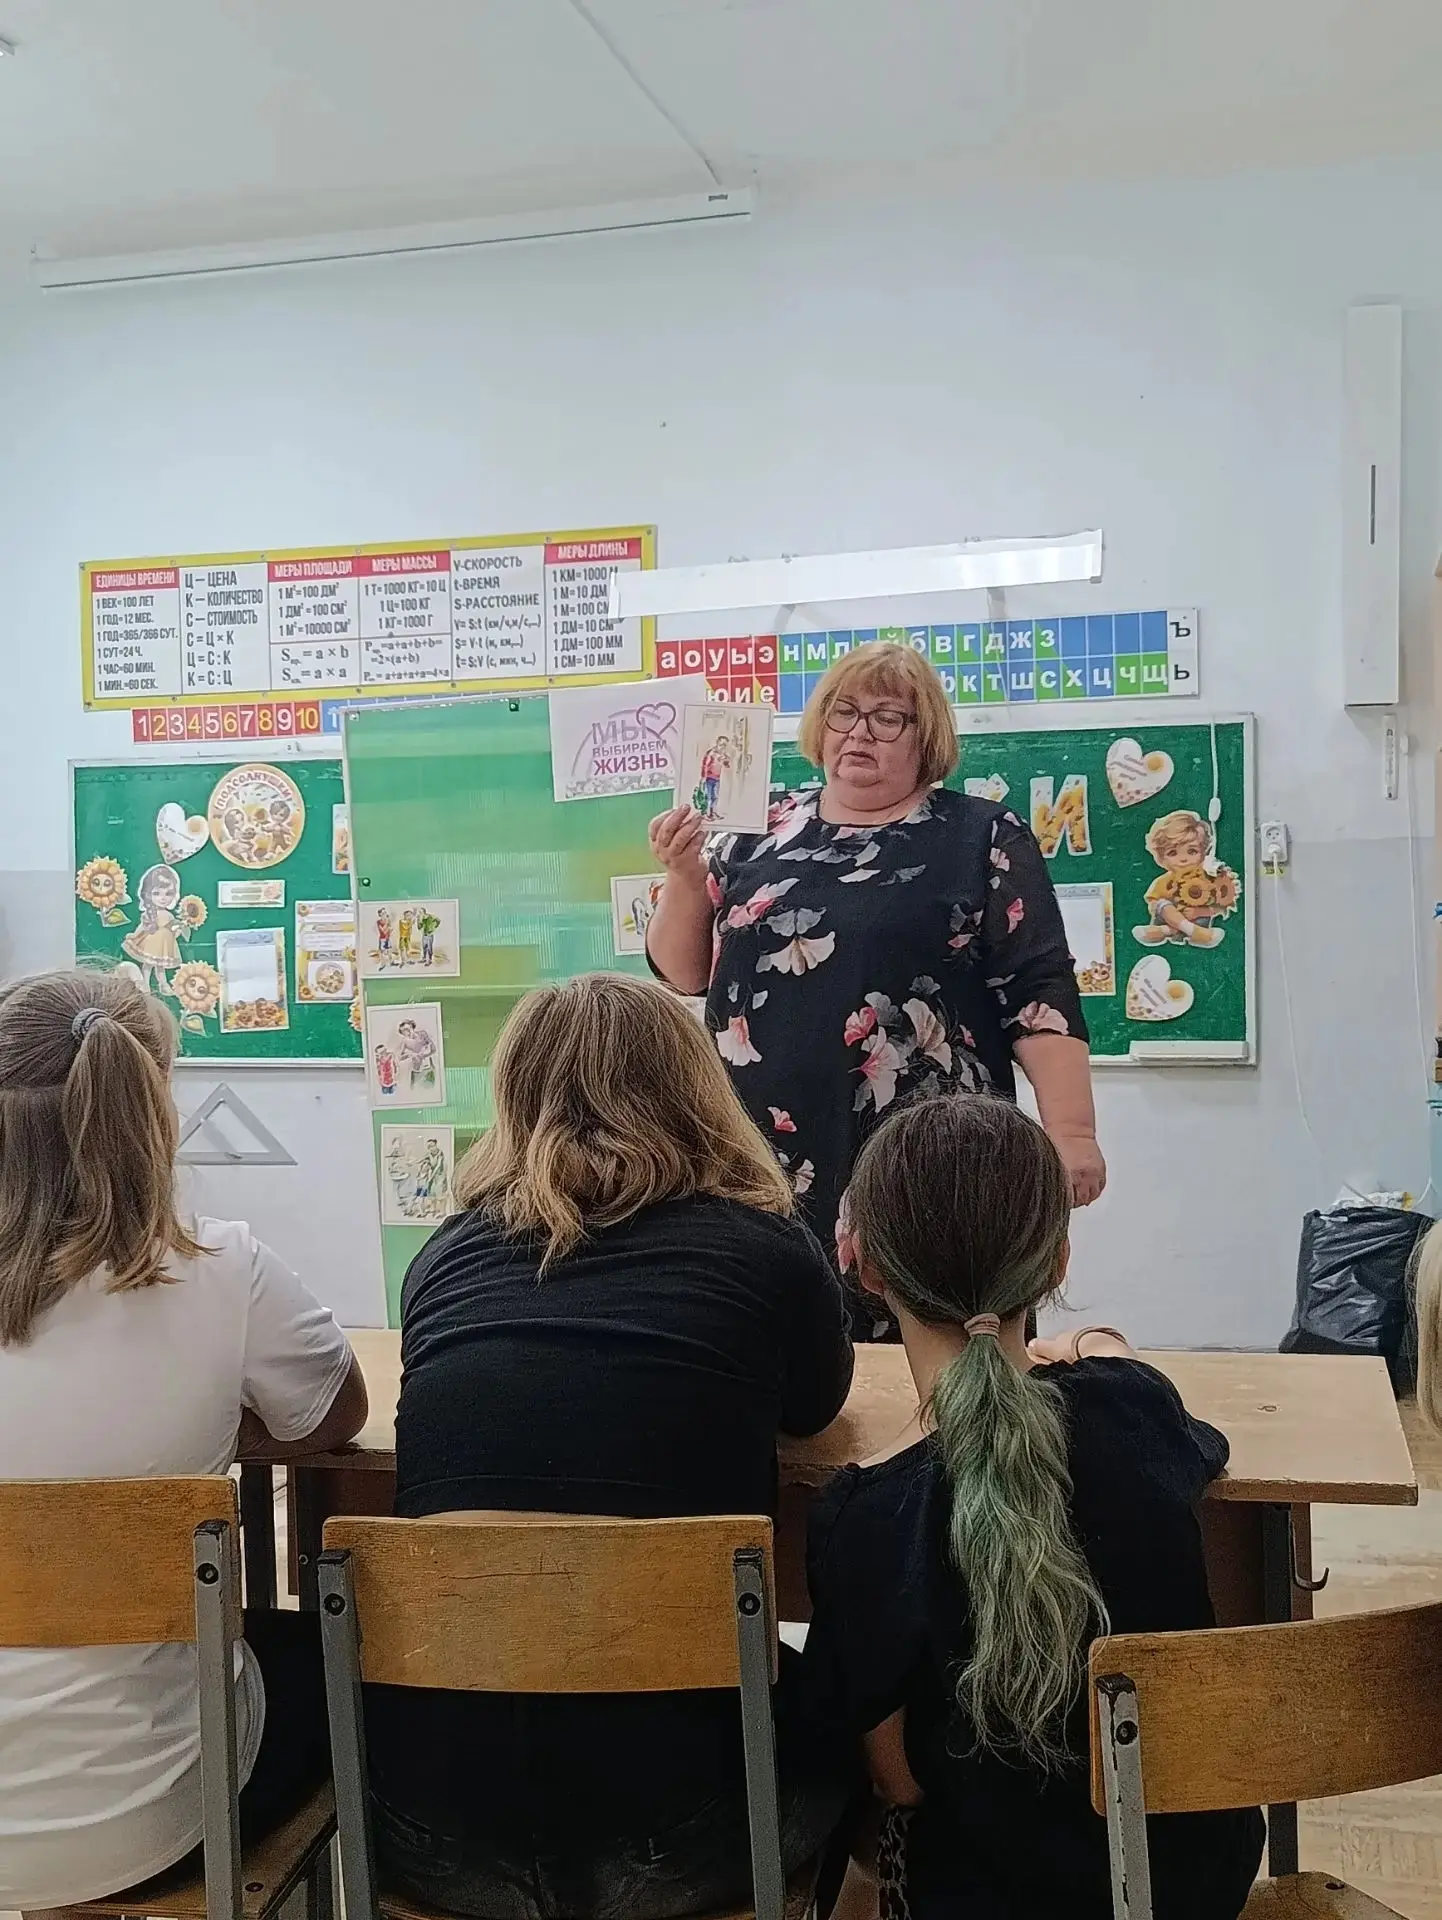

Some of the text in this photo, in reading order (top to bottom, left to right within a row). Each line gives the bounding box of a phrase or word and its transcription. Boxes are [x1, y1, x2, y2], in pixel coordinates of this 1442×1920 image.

[557, 541, 628, 559] МЕРЫ ДЛИНЫ
[274, 560, 353, 578] МЕРЫ ПЛОЩАДИ
[372, 554, 437, 572] МЕРЫ МАССЫ
[96, 571, 175, 588] ЕДИНИЦЫ ВРЕМЕНИ
[185, 571, 237, 589] Ц ЦЕНА
[186, 589, 264, 608] К КОЛИЧЕСТВО
[590, 584, 607, 599] ДМ
[139, 596, 154, 606] ЛЕТ
[419, 597, 431, 609] КГ
[135, 612, 154, 623] МЕС.
[186, 609, 258, 627] С СТОИМОСТЬ
[160, 628, 178, 639] СУТ.
[605, 635, 623, 648] ММ
[135, 646, 143, 657] Ч.
[597, 652, 615, 666] ММ
[135, 662, 155, 673] МИН.
[141, 678, 158, 690] СЕК.
[137, 715, 147, 736] 1
[152, 715, 166, 736] 2
[170, 714, 184, 735] 3
[187, 714, 201, 734] 4
[206, 712, 220, 733] 5
[223, 712, 237, 733] 6
[240, 710, 254, 732] 7
[259, 710, 273, 731] 8
[277, 709, 292, 730] 9
[296, 707, 318, 730] 10
[592, 717, 647, 745] МЫ
[592, 740, 667, 758] ВЫБИРАЕМ
[594, 753, 668, 776] ЖИЗНЬ
